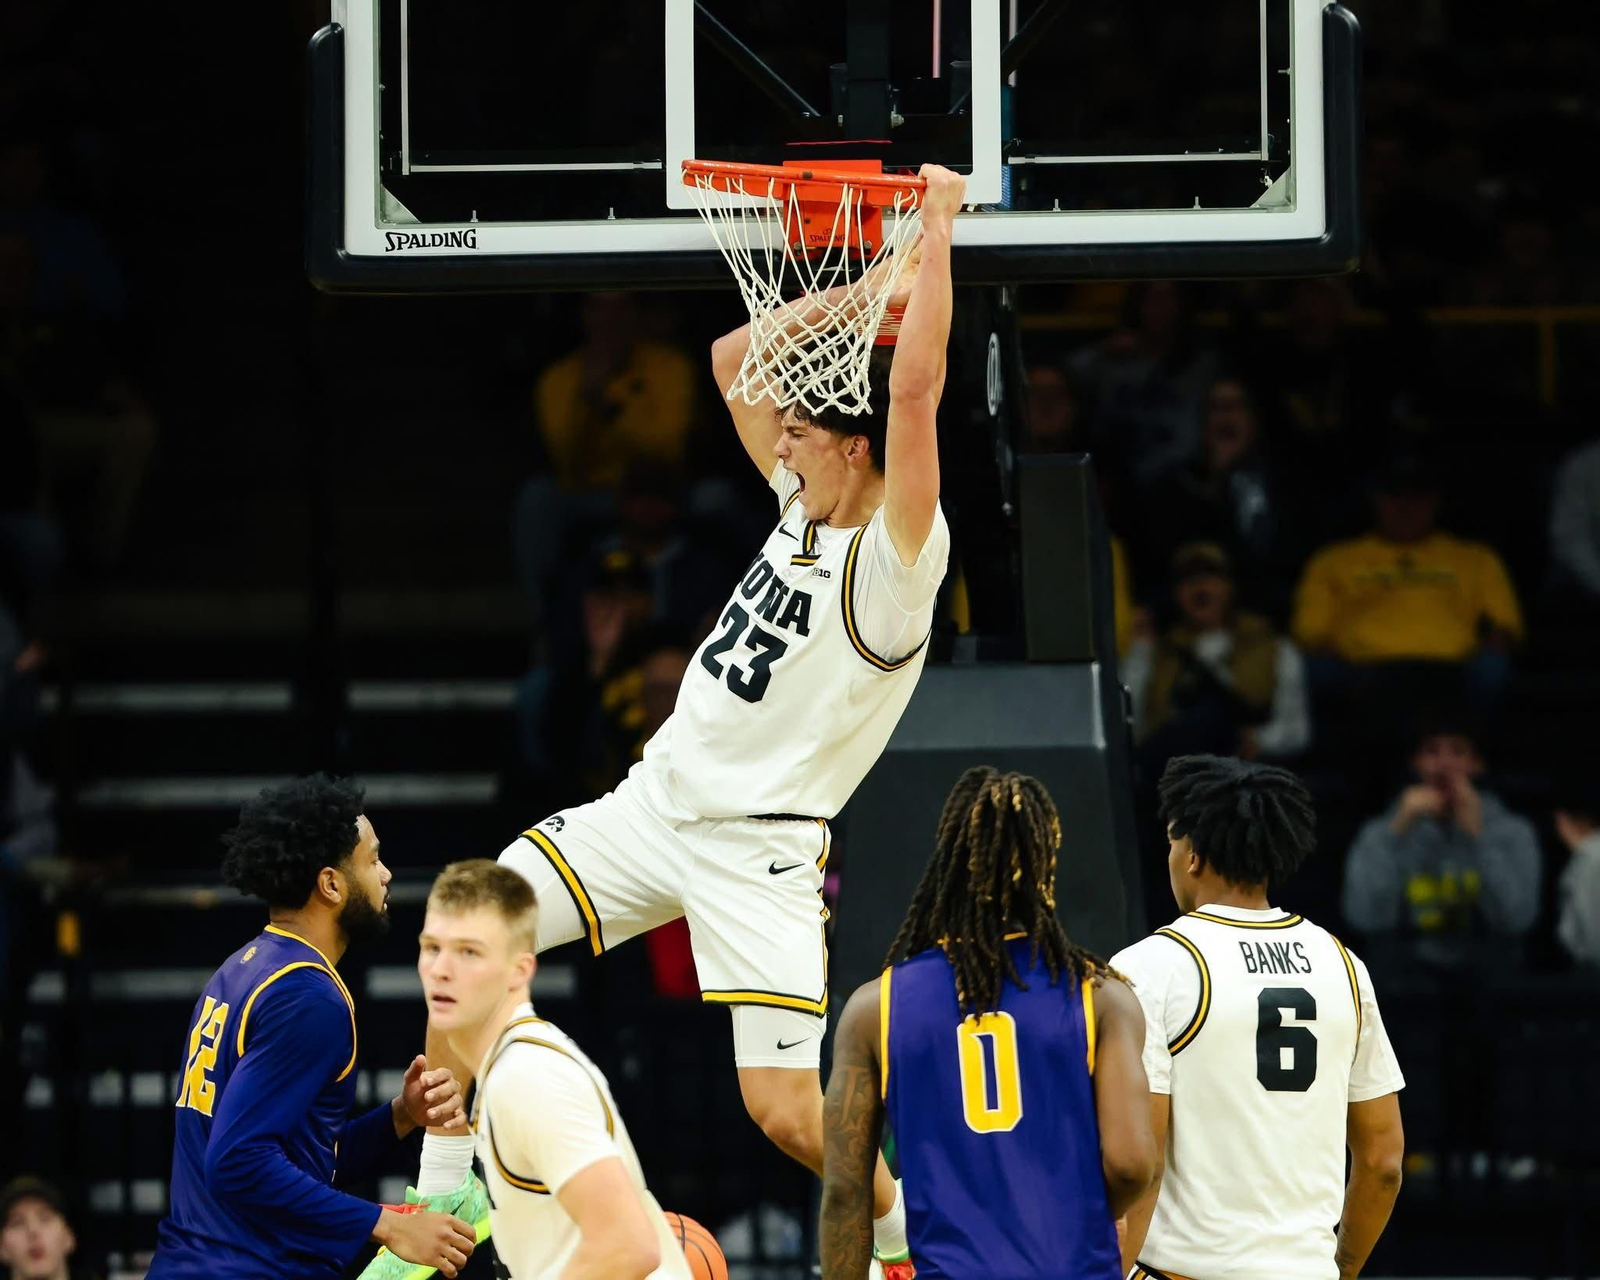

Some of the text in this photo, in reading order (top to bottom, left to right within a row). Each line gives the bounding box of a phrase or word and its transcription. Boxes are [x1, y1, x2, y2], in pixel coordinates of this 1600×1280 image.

[385, 229, 477, 252] SPALDING
[701, 601, 788, 703] 23
[1238, 941, 1312, 974] BANKS
[175, 995, 230, 1117] 12
[957, 1010, 1024, 1134] 0
[1256, 987, 1318, 1092] 6
